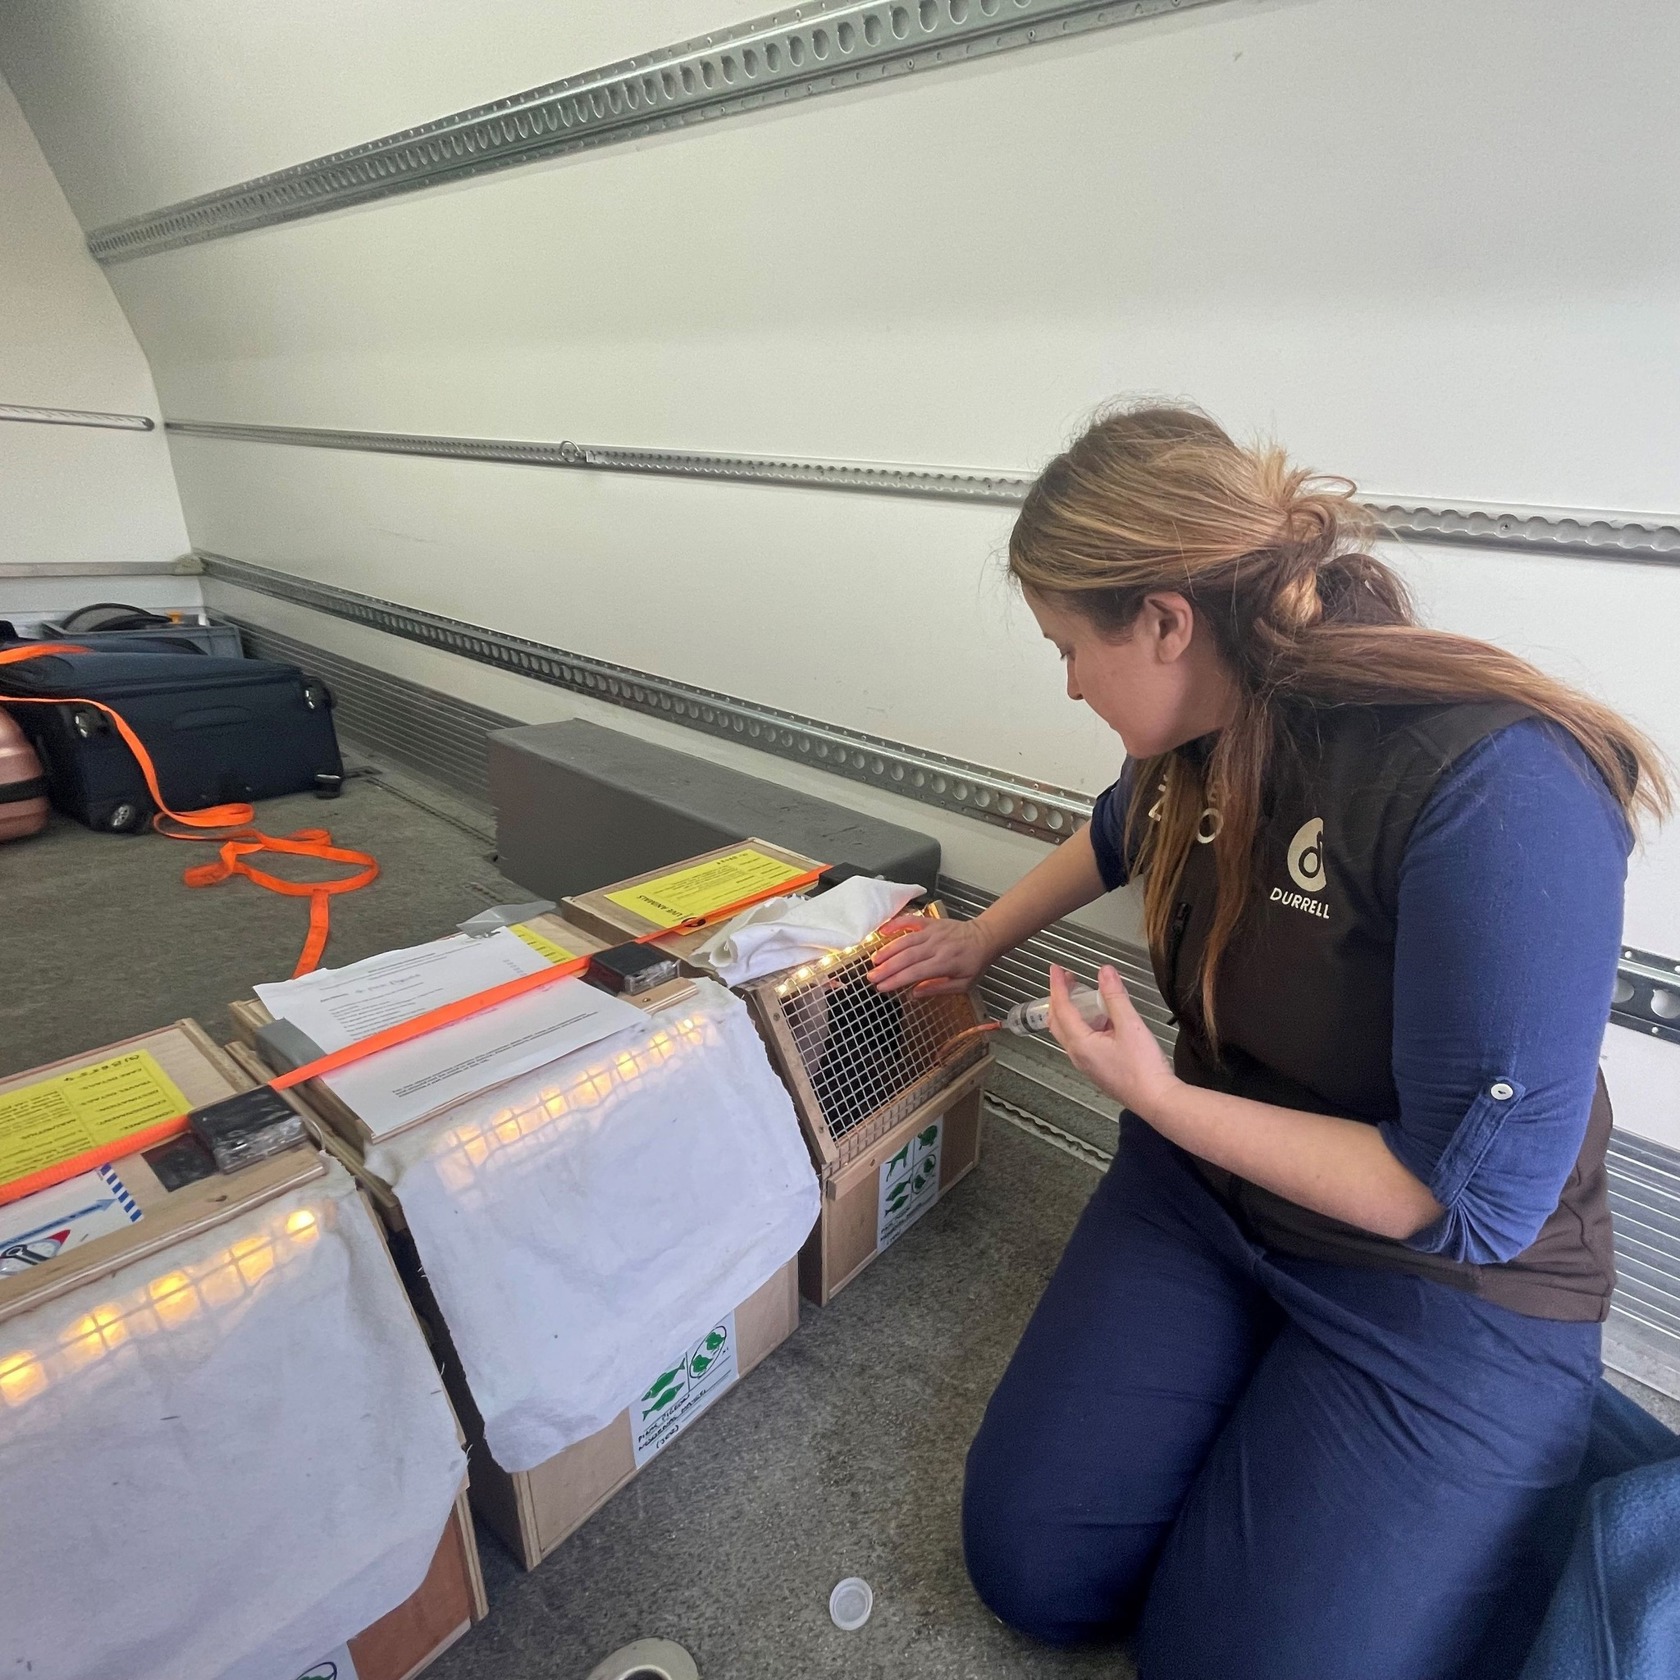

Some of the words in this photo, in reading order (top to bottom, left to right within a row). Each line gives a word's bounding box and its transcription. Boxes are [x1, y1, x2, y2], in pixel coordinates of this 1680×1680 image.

[636, 894, 669, 910] ANIMALS
[1269, 887, 1330, 919] DURRELL
[665, 908, 683, 918] LIVE
